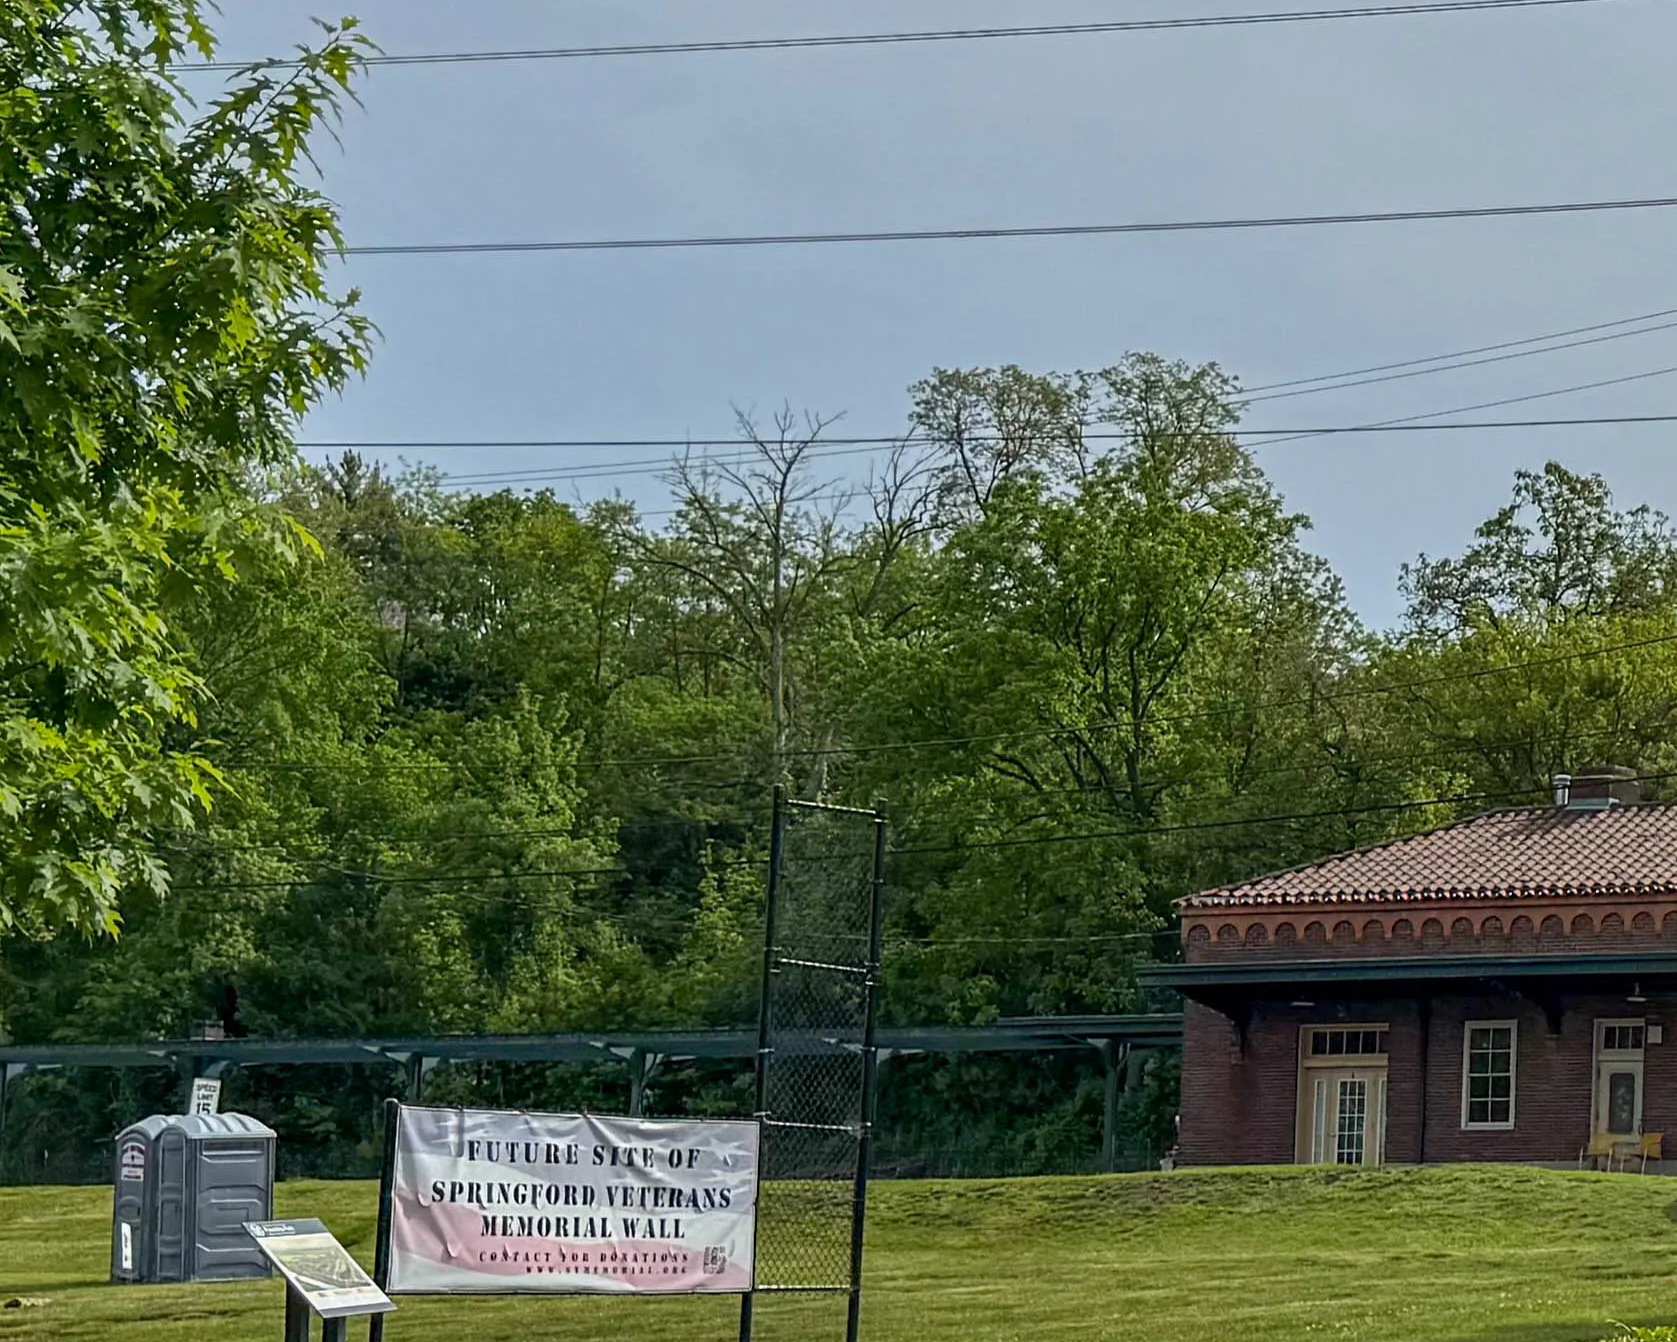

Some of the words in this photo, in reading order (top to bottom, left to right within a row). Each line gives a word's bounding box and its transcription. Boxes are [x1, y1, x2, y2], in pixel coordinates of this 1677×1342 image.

[196, 1103, 211, 1115] 15
[467, 1140, 579, 1165] FUTURE
[592, 1145, 655, 1169] SITE
[668, 1148, 701, 1169] OF
[431, 1180, 596, 1209] SPRINGFORD
[606, 1185, 732, 1209] VETERANS
[480, 1215, 613, 1238] MEMORIAL
[622, 1217, 685, 1239] WALL
[479, 1251, 551, 1263] CONTACT
[600, 1252, 689, 1264] DONATIONS
